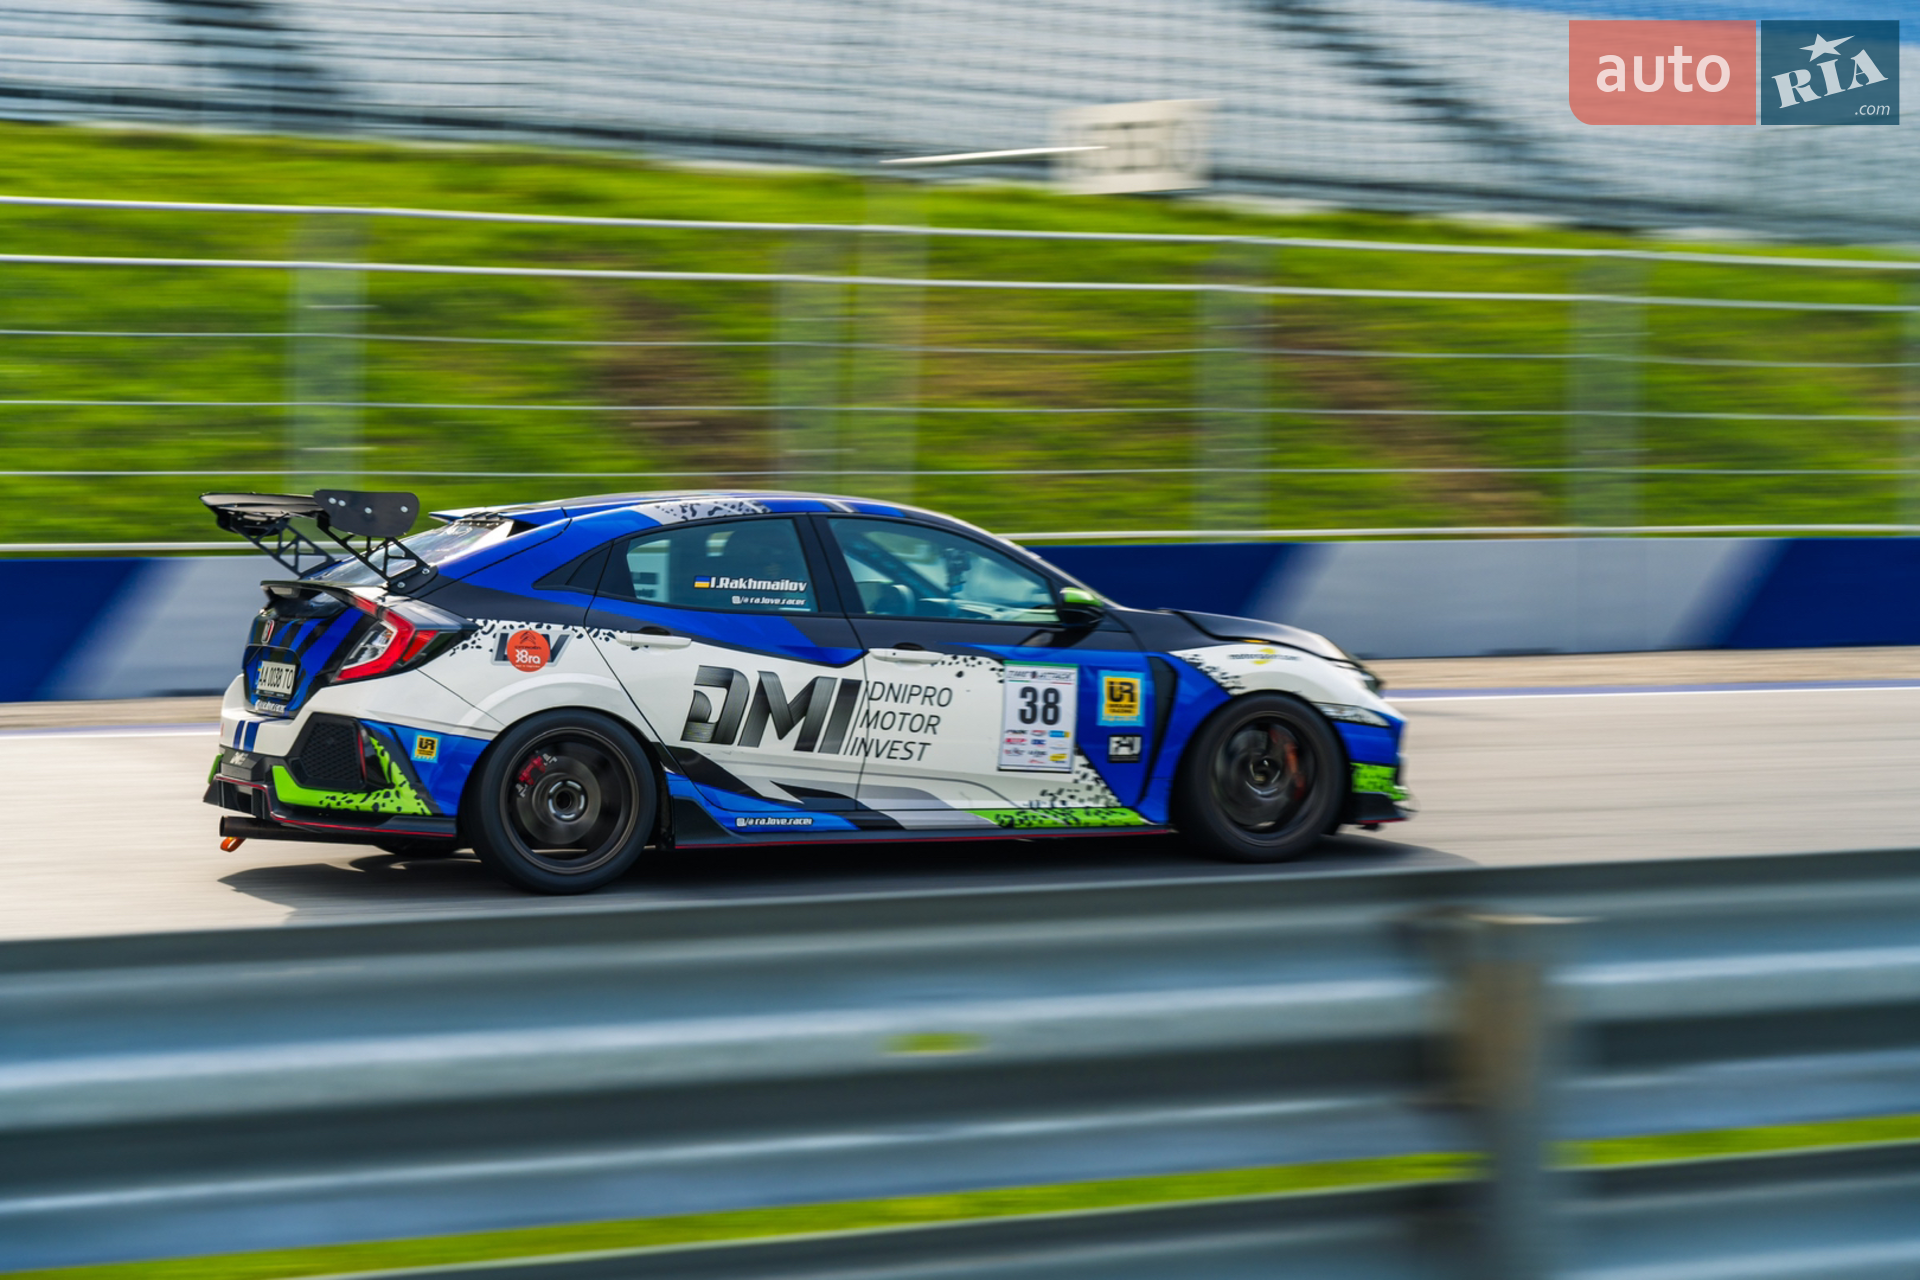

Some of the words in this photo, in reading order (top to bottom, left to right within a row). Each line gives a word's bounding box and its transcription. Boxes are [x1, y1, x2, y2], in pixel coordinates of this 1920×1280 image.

[710, 576, 807, 592] I.Rakhmailov
[868, 680, 953, 708] DNIPRO
[1018, 686, 1062, 726] 38
[680, 664, 863, 756] DMI
[859, 709, 941, 735] MOTOR
[849, 736, 932, 762] INVEST
